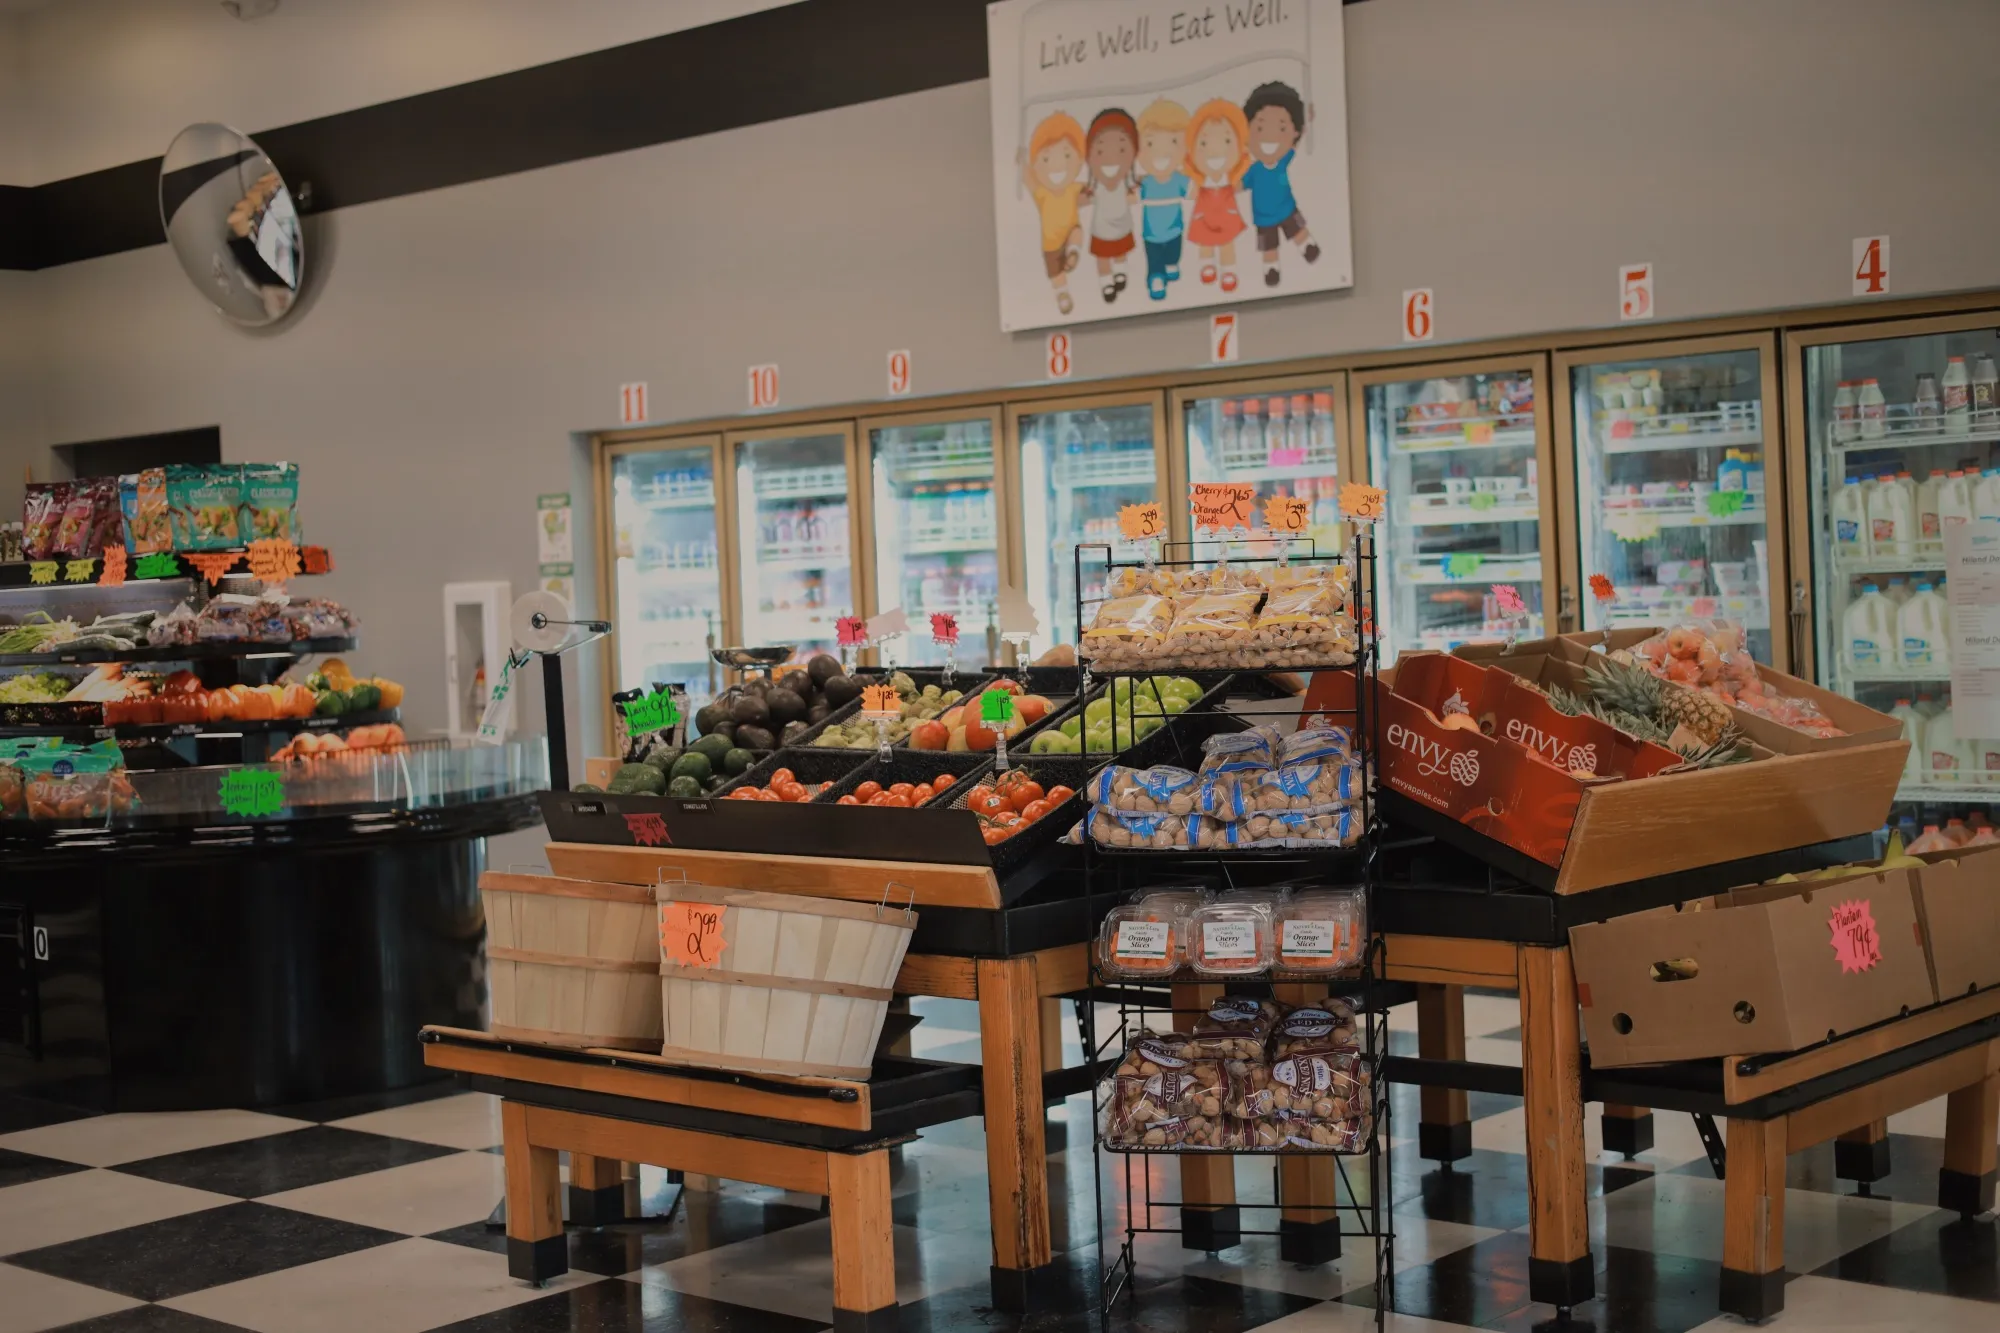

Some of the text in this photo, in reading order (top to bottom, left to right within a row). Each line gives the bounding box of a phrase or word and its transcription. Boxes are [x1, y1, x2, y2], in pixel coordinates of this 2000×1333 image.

[1040, 0, 1289, 70] Live Well, Eat Well.
[1856, 239, 1886, 293] 4
[1623, 267, 1650, 318] 5
[1406, 291, 1430, 339] 6
[1049, 333, 1070, 377] 8
[1214, 315, 1234, 359] 7
[750, 366, 779, 406] 10
[889, 353, 909, 393] 9
[622, 384, 646, 423] 11
[1193, 501, 1219, 518] Orange
[1195, 484, 1223, 498] Cherry
[1197, 514, 1218, 525] Slices
[1387, 723, 1452, 776] envy
[1506, 718, 1569, 768] envy
[1391, 776, 1449, 809] envyapples.com
[1127, 935, 1154, 943] Orange
[1215, 935, 1240, 943] Cherry
[1218, 941, 1238, 949] Slices
[1293, 934, 1320, 942] Orange
[1296, 940, 1316, 948] Slices
